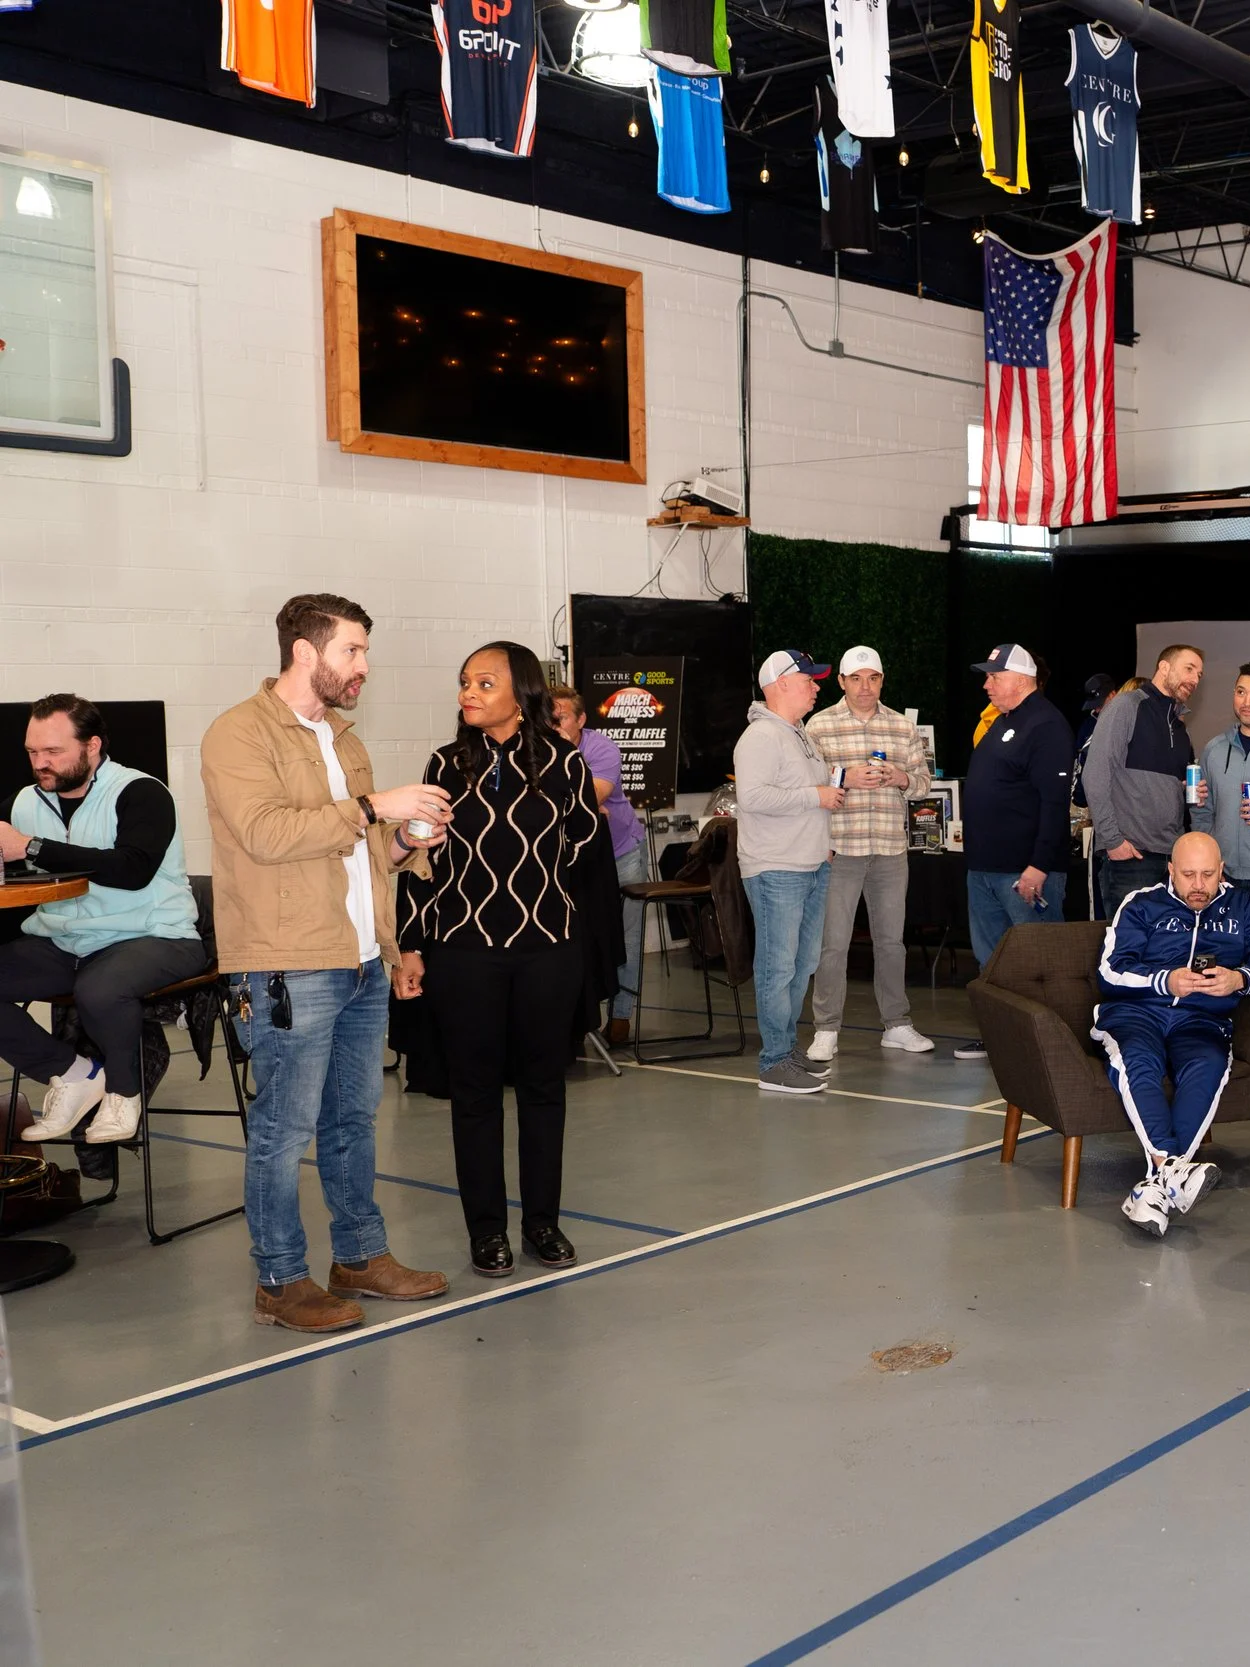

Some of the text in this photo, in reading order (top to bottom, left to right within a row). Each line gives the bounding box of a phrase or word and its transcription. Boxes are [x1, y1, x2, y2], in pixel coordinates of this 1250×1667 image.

[613, 694, 651, 706] MARCH
[607, 706, 656, 718] MADNESS
[632, 728, 667, 739] RAFFLE
[628, 753, 653, 761] PRICES
[1155, 917, 1239, 935] ETRE
